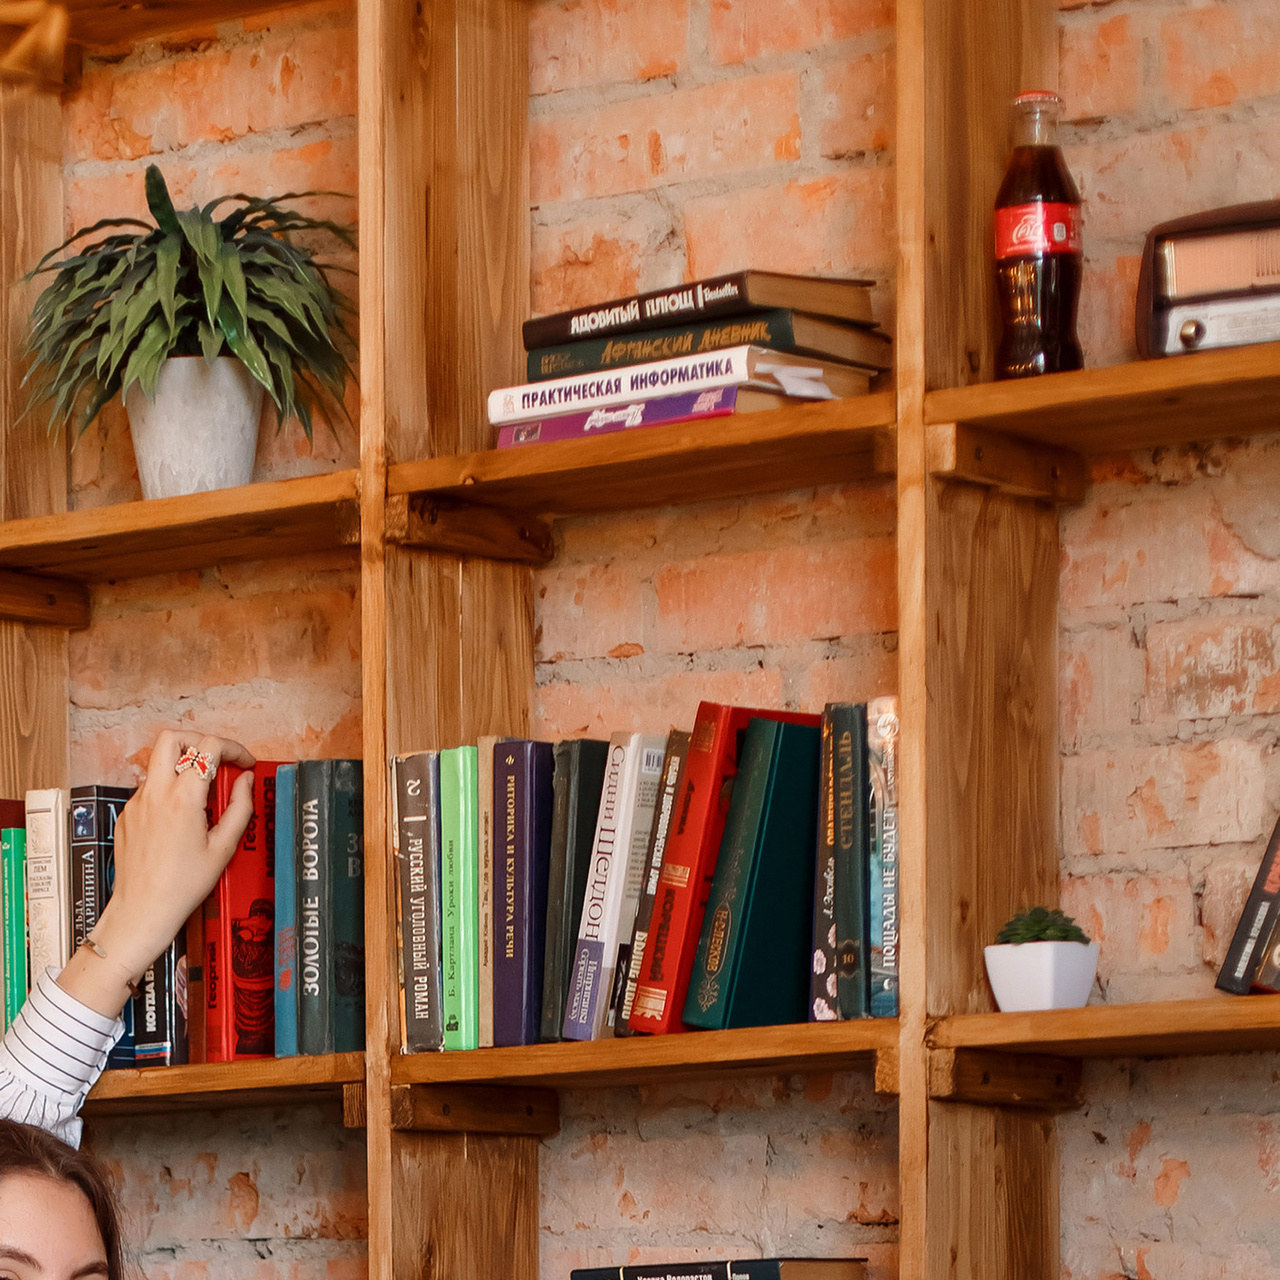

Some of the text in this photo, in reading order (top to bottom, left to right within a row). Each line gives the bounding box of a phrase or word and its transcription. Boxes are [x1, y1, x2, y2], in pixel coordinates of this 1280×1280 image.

[570, 300, 641, 336] ЯДОВИТЫЙ
[646, 289, 695, 318] ПЛЮЩ
[522, 357, 734, 409] ПРАКТИЧЕСКАЯ ИНФОРМАТИКА
[838, 731, 854, 850] СТЕНДАЛЬ
[504, 775, 516, 958] РИТОРИКА КУЛЬТУРА РЕЧИ
[584, 745, 626, 942] Сидни Шелдон
[651, 794, 673, 868] ДОБРОВОЛЬЧЕСКАЯ
[882, 808, 897, 863] БУДЕТ
[302, 798, 320, 997] ЗОЛОТЫЕ ВОРОТА
[447, 838, 457, 980] Картланд Уроки любви
[883, 867, 897, 890] НЕ
[410, 838, 429, 1020] РУССКИЙ УГОЛОВНЫЙ РОМАН
[842, 952, 854, 965] 10
[882, 894, 898, 968] ПОЩАДЫ
[145, 981, 158, 1033] КОГДА
[207, 942, 218, 1010] Георгий
